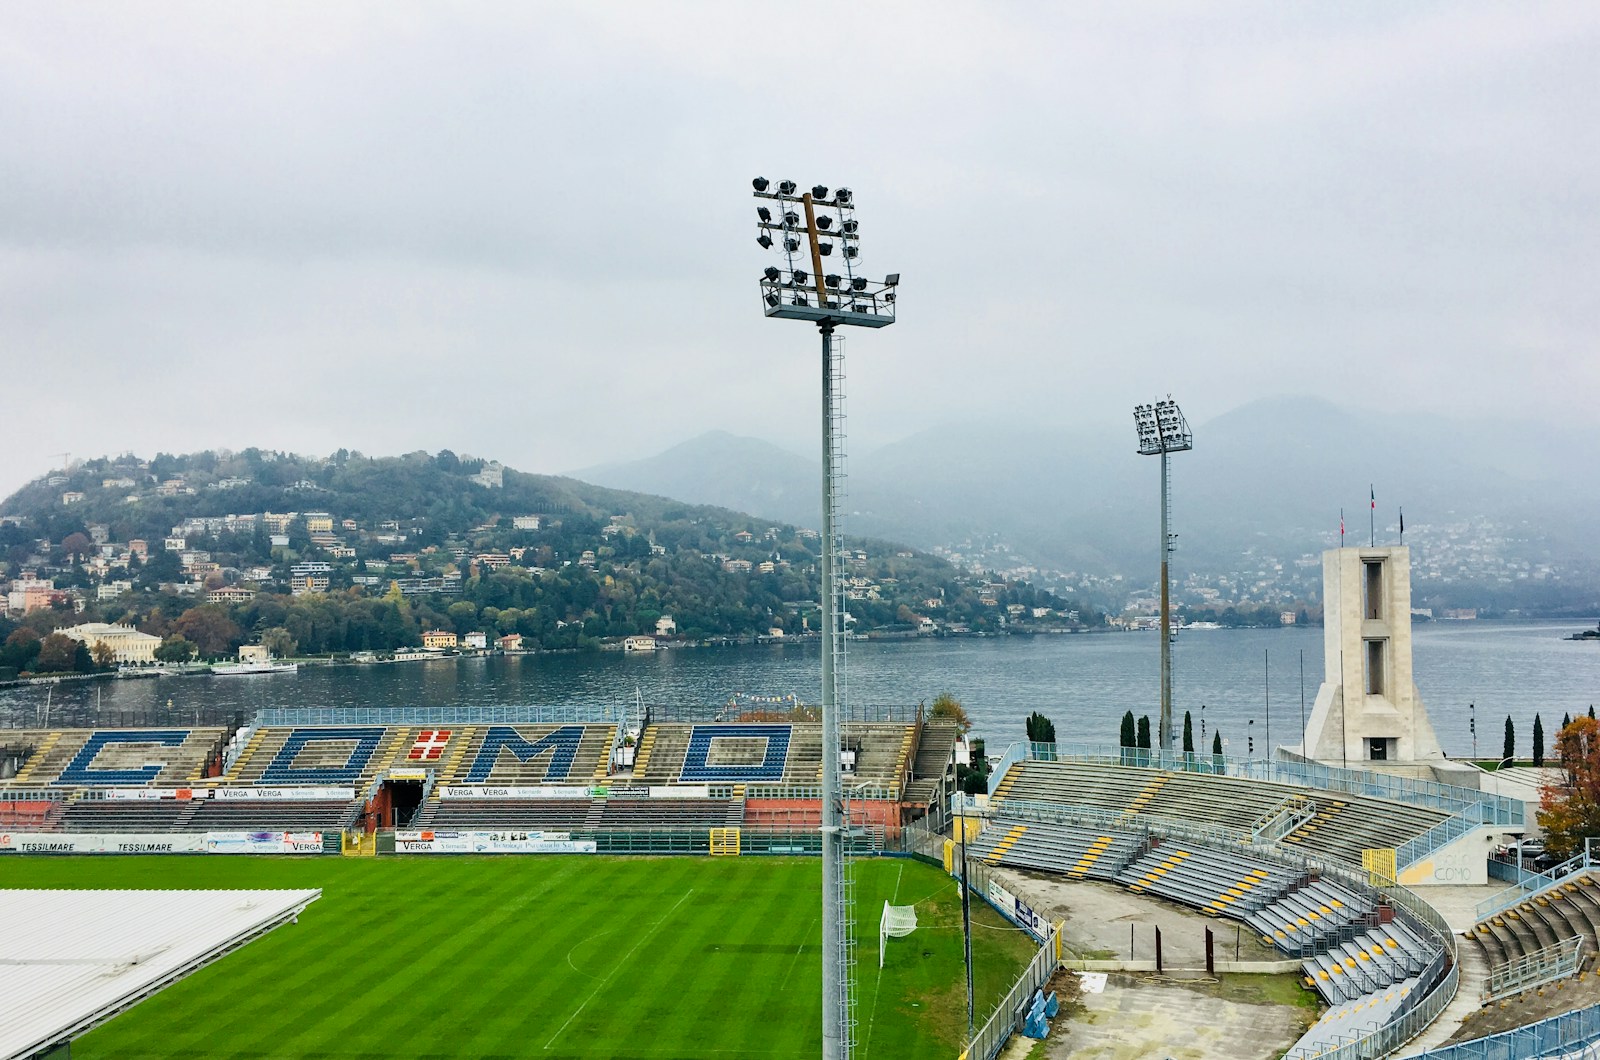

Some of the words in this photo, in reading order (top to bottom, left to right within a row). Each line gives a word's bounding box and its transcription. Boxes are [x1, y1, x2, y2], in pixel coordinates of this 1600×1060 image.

[223, 789, 248, 797] VERGA
[257, 789, 282, 797] VERGA
[448, 788, 473, 796] VERGA
[482, 788, 508, 796] VERGA
[22, 843, 75, 851] TESSILMARE
[292, 842, 321, 851] VERGA
[404, 841, 432, 851] VERGA
[1434, 867, 1472, 881] COMO
